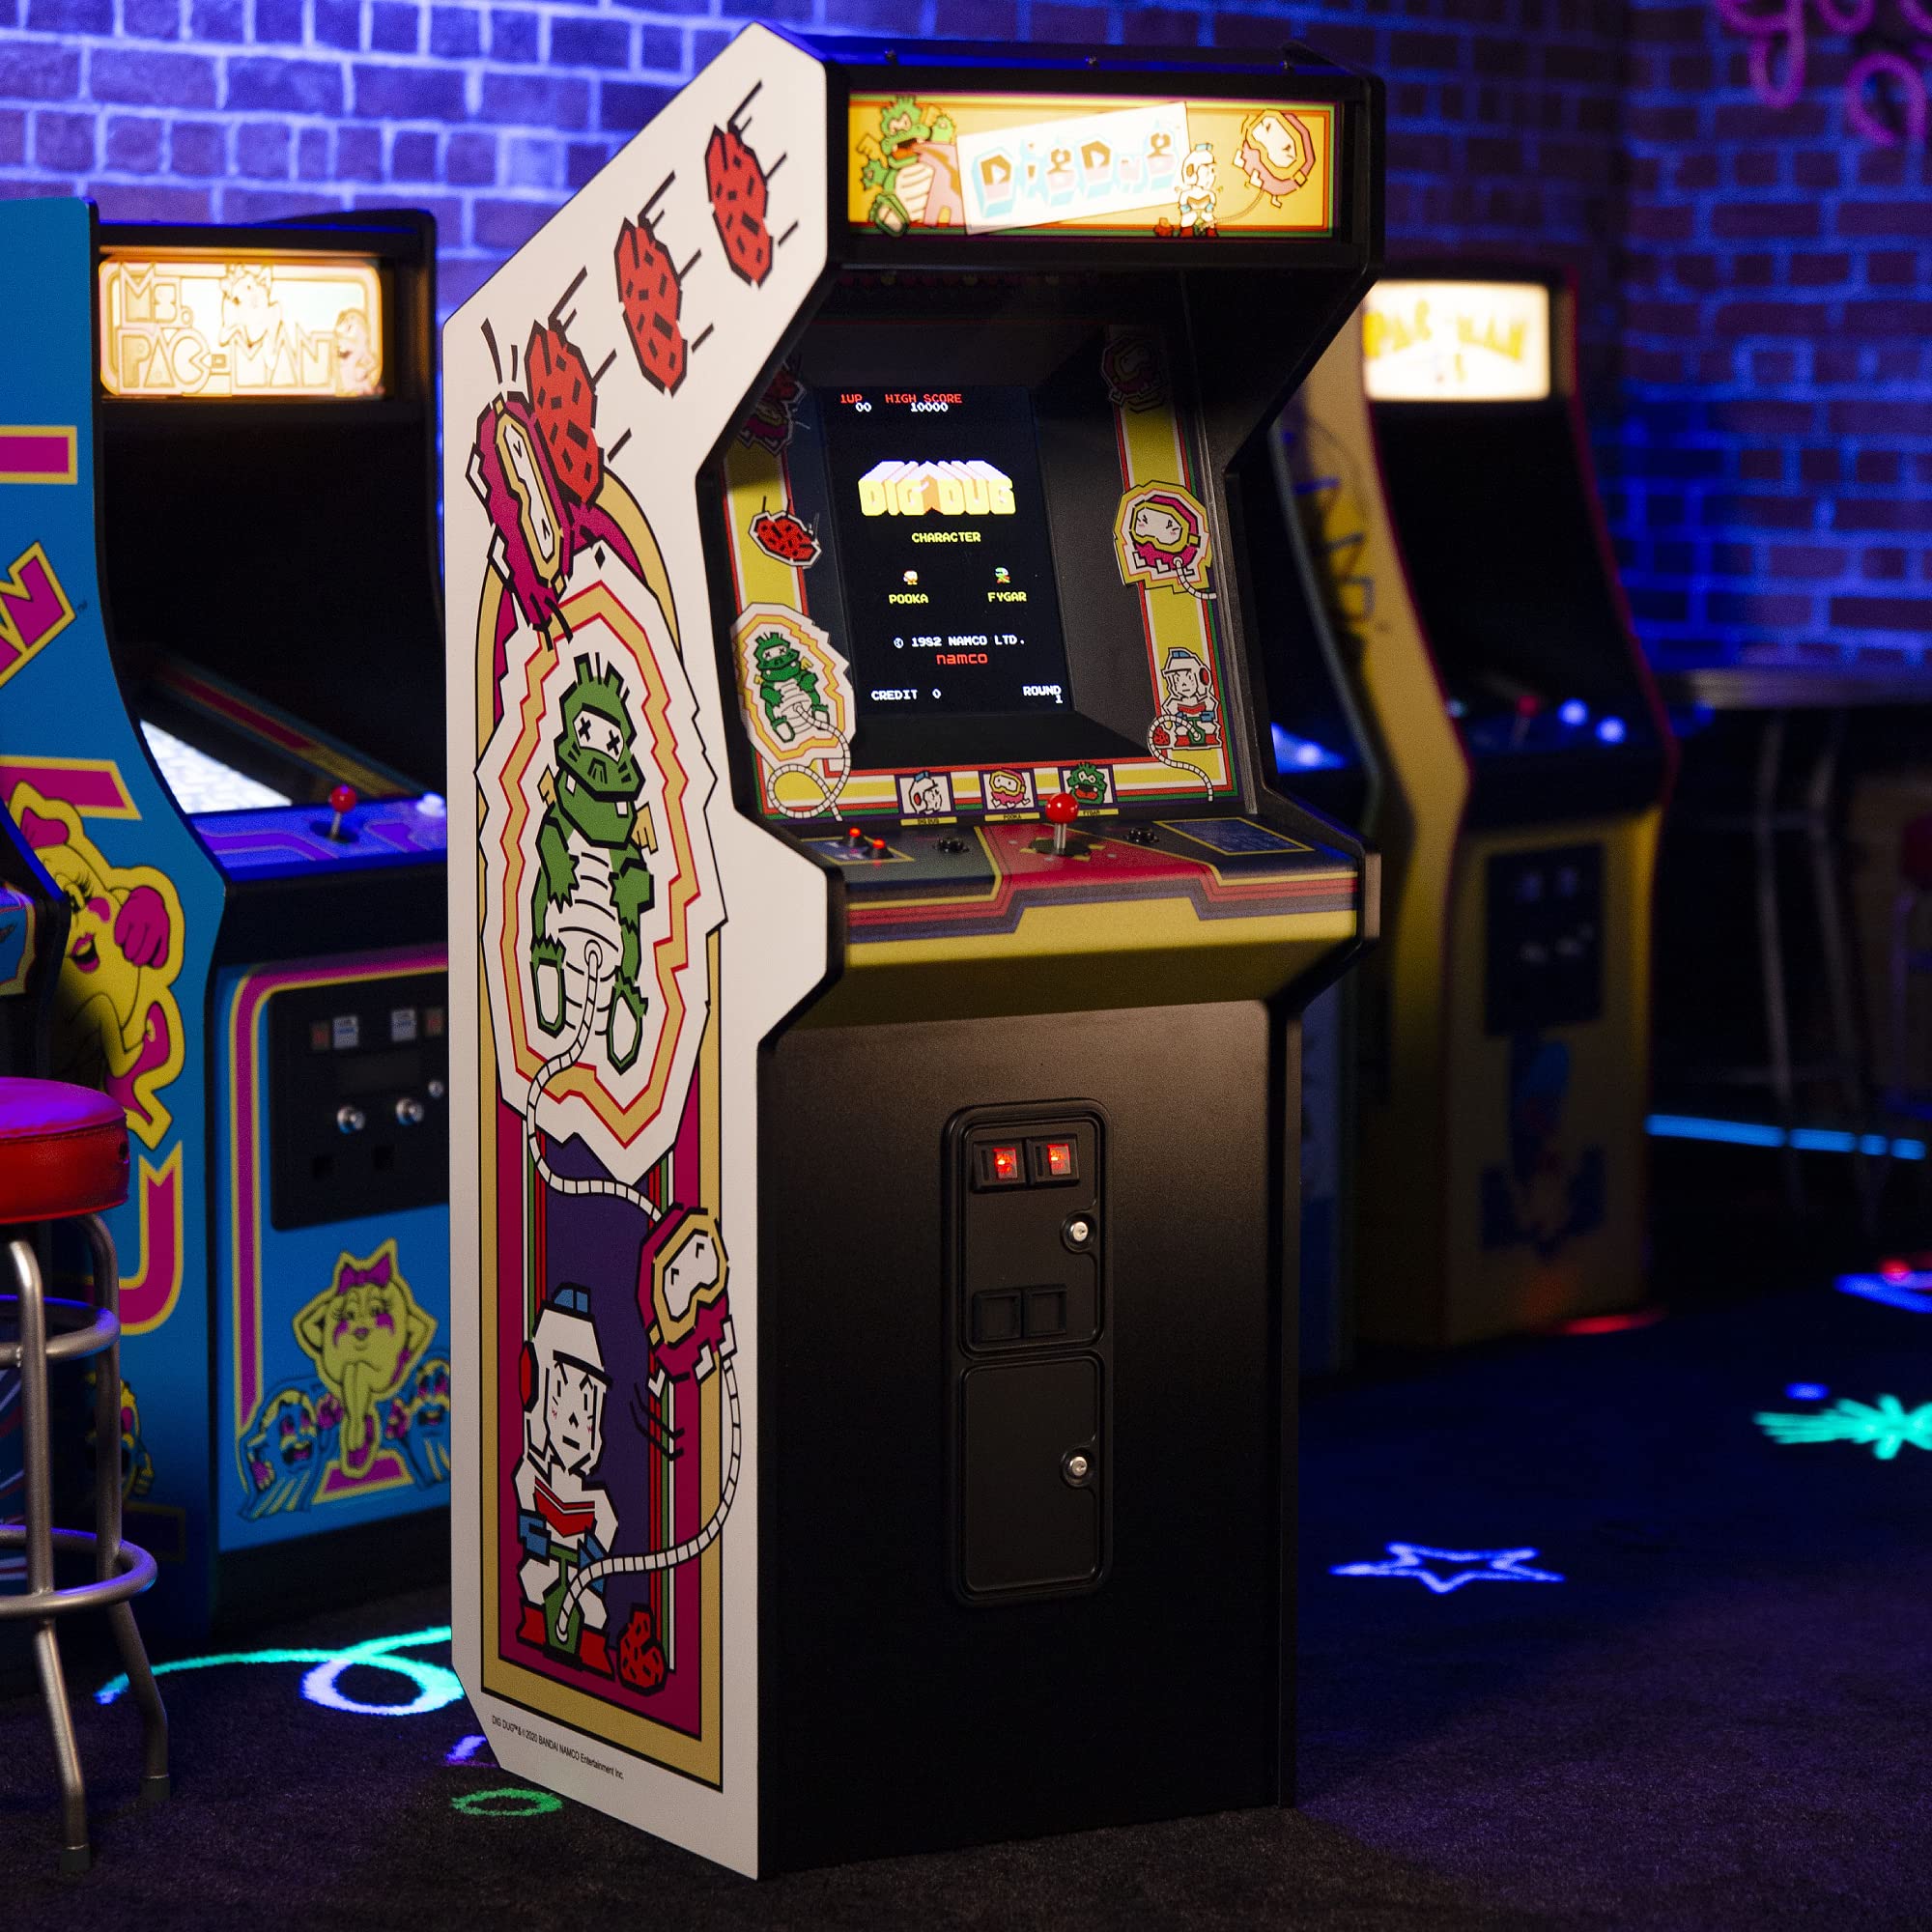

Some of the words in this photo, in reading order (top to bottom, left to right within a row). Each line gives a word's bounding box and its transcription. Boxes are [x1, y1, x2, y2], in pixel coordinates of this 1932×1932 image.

[119, 262, 193, 326] Ms.
[118, 323, 336, 395] PAC-MAN
[840, 394, 863, 404] 1UP
[885, 394, 917, 404] HIGH
[923, 394, 962, 404] SCORE
[856, 402, 872, 412] 00
[911, 402, 949, 412] 10000
[858, 464, 927, 516] DIG
[939, 464, 1016, 515] DUG
[911, 532, 981, 543] CHARACTER
[889, 594, 928, 604] POOKA
[987, 591, 1027, 602] FYGAR
[912, 637, 942, 647] 1982
[948, 635, 987, 646] NAMCO
[994, 634, 1025, 645] LTD.
[936, 653, 988, 665] namco
[870, 689, 918, 700] CREDIT
[932, 688, 941, 698] 0
[1022, 685, 1062, 696] ROUND
[1055, 694, 1063, 704] 1
[492, 1715, 501, 1727] DIG
[538, 1735, 558, 1752] BANDAI
[559, 1743, 580, 1761] NAMCO
[581, 1752, 614, 1776] Entertainment
[614, 1767, 624, 1779] Inc.
